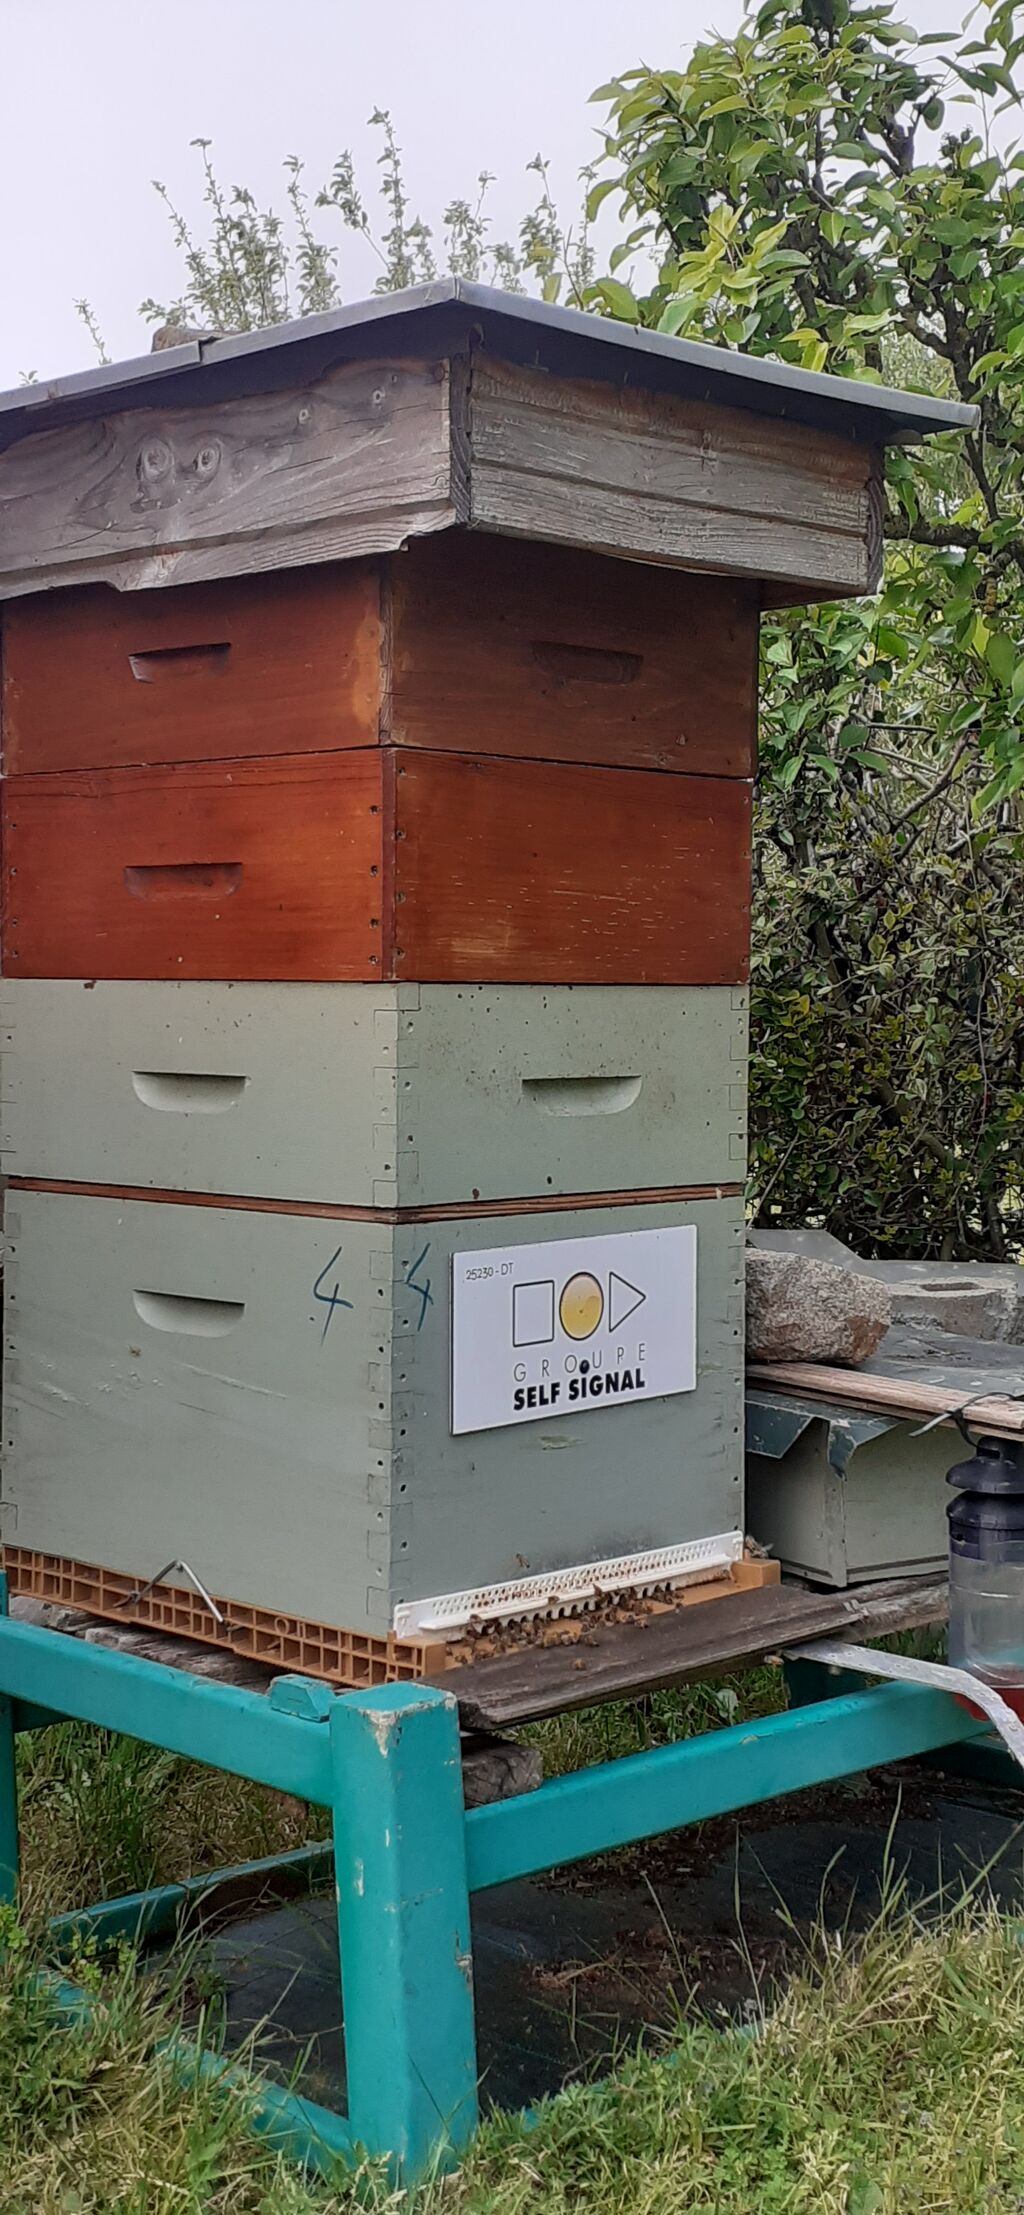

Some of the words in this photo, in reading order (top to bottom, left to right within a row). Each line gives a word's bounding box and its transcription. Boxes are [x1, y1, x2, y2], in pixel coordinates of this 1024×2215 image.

[313, 1246, 354, 1346] 4
[405, 1242, 434, 1332] 4
[513, 1343, 646, 1382] GROUPE
[513, 1382, 560, 1411] SELF
[568, 1368, 645, 1401] SIGNAL
